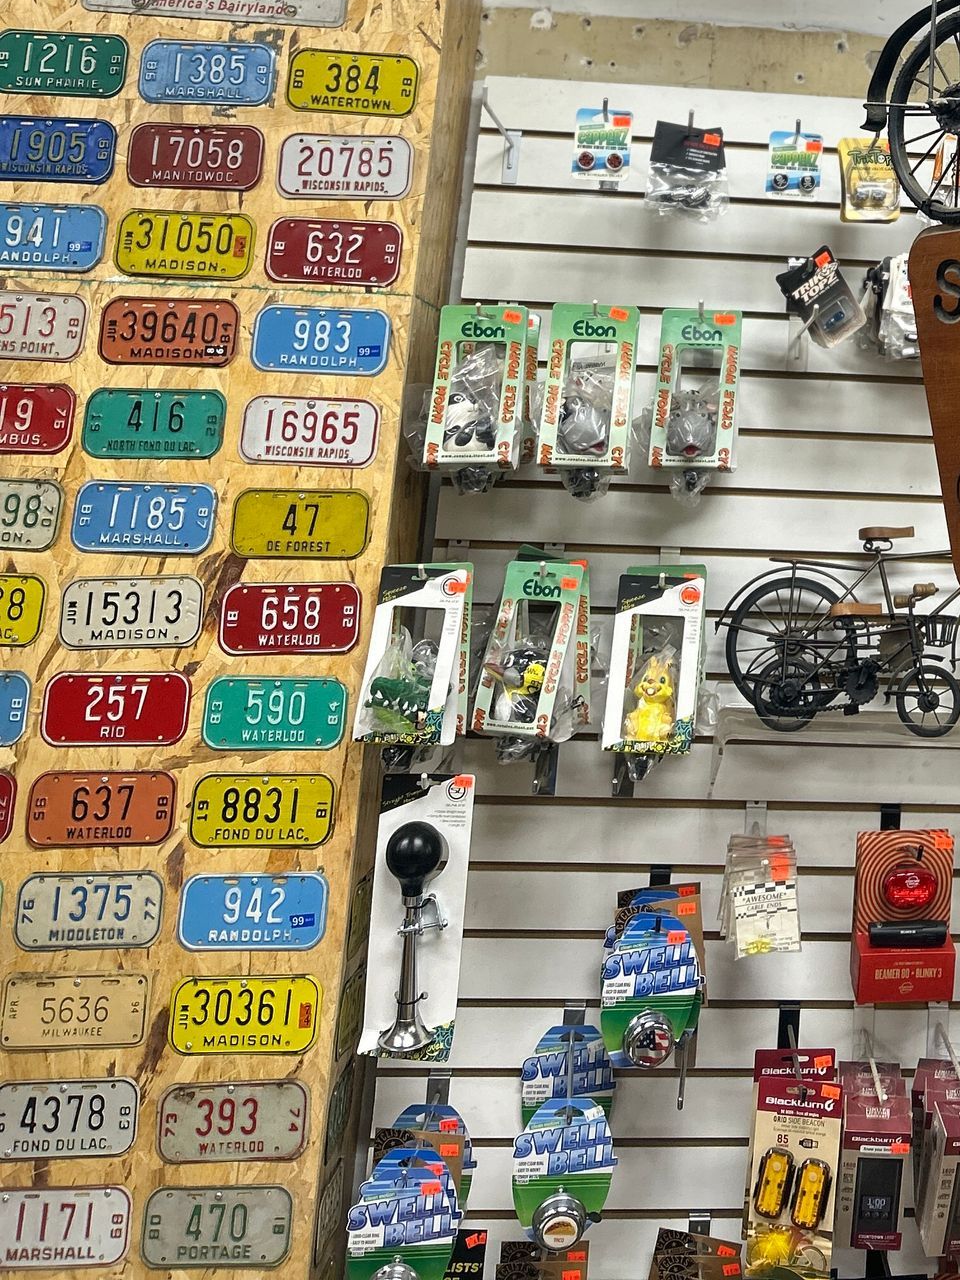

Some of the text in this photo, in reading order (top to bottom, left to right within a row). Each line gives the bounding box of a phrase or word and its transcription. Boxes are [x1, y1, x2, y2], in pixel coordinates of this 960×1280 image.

[218, 0, 285, 15] Dairyland
[23, 42, 98, 75] 1216
[174, 53, 246, 85] 1385
[16, 76, 99, 89] SUN PRAIRIE
[324, 63, 380, 95] 384
[165, 87, 243, 99] MARSHALL
[310, 95, 391, 110] WATERTOWN
[10, 129, 87, 163] 1905
[152, 135, 244, 169] 17058
[1, 162, 89, 175] WISCONSIN RAPIDS
[297, 146, 394, 178] 20785
[152, 171, 234, 183] MANITOWOC
[302, 180, 385, 192] WISCONSIN RAPIDS
[6, 215, 62, 247] 941
[136, 218, 233, 255] 31050
[306, 231, 364, 264] 632
[145, 259, 219, 272] MADISON
[303, 265, 363, 279] WATERLOO
[792, 271, 838, 303] TRIK TOPZ
[120, 310, 216, 344] 39640
[292, 319, 351, 353] 983
[461, 321, 506, 338] Ebon
[572, 320, 617, 338] Ebon
[681, 324, 723, 342] Ebon
[21, 342, 55, 355] POINT
[130, 347, 204, 360] MADISON
[358, 348, 370, 357] 99
[279, 353, 357, 368] RANDOLPH
[127, 400, 185, 433] 416
[265, 409, 360, 444] 16965
[107, 440, 196, 453] NORTH FOND LAC
[265, 446, 350, 460] WISCONSIN RAPIDS
[109, 494, 188, 530] 1185
[282, 504, 320, 536] 47
[99, 532, 181, 545] MARSHALL
[266, 541, 330, 553] DE FOREST
[523, 579, 562, 598] Ebon
[85, 589, 183, 625] 15313
[261, 596, 322, 630] 658
[556, 601, 575, 645] HORN
[90, 628, 169, 641] MADISON
[258, 634, 321, 646] WATERLOO
[85, 684, 149, 722] 257
[245, 689, 306, 725] 590
[100, 725, 125, 739] RIO
[242, 730, 305, 743] WATERLOO
[70, 784, 135, 822] 637
[221, 787, 299, 824] 8831
[66, 826, 132, 839] WATERLOO
[214, 828, 305, 840] FOND DU LAC
[52, 884, 133, 922] 1375
[223, 886, 286, 925] 942
[746, 903, 764, 911] CABLE
[292, 917, 304, 926] 99
[48, 928, 124, 942] MIDDLETON
[208, 930, 292, 942] RANDOLPH
[602, 943, 700, 997] SWELL BELL
[875, 968, 942, 979] BEAMER 80 3
[41, 995, 109, 1024] 5636
[191, 988, 293, 1027] 30361
[42, 1026, 103, 1037] MILWAUKEE
[203, 1034, 282, 1047] MADISON
[20, 1094, 107, 1135] 4378
[195, 1097, 259, 1137] 393
[13, 1137, 107, 1153] FOND DU LAC
[199, 1140, 265, 1155] WATERLOO
[513, 1121, 611, 1158] SWELL
[777, 1133, 789, 1144] 85
[851, 1136, 896, 1144] Blackburn
[547, 1144, 618, 1176] BELL
[348, 1191, 449, 1230] SWELL
[15, 1202, 94, 1242] 1171
[185, 1203, 248, 1243] 470
[383, 1215, 457, 1247] BELL
[5, 1247, 96, 1262] MARSHALL
[176, 1245, 252, 1260] PORTAGE
